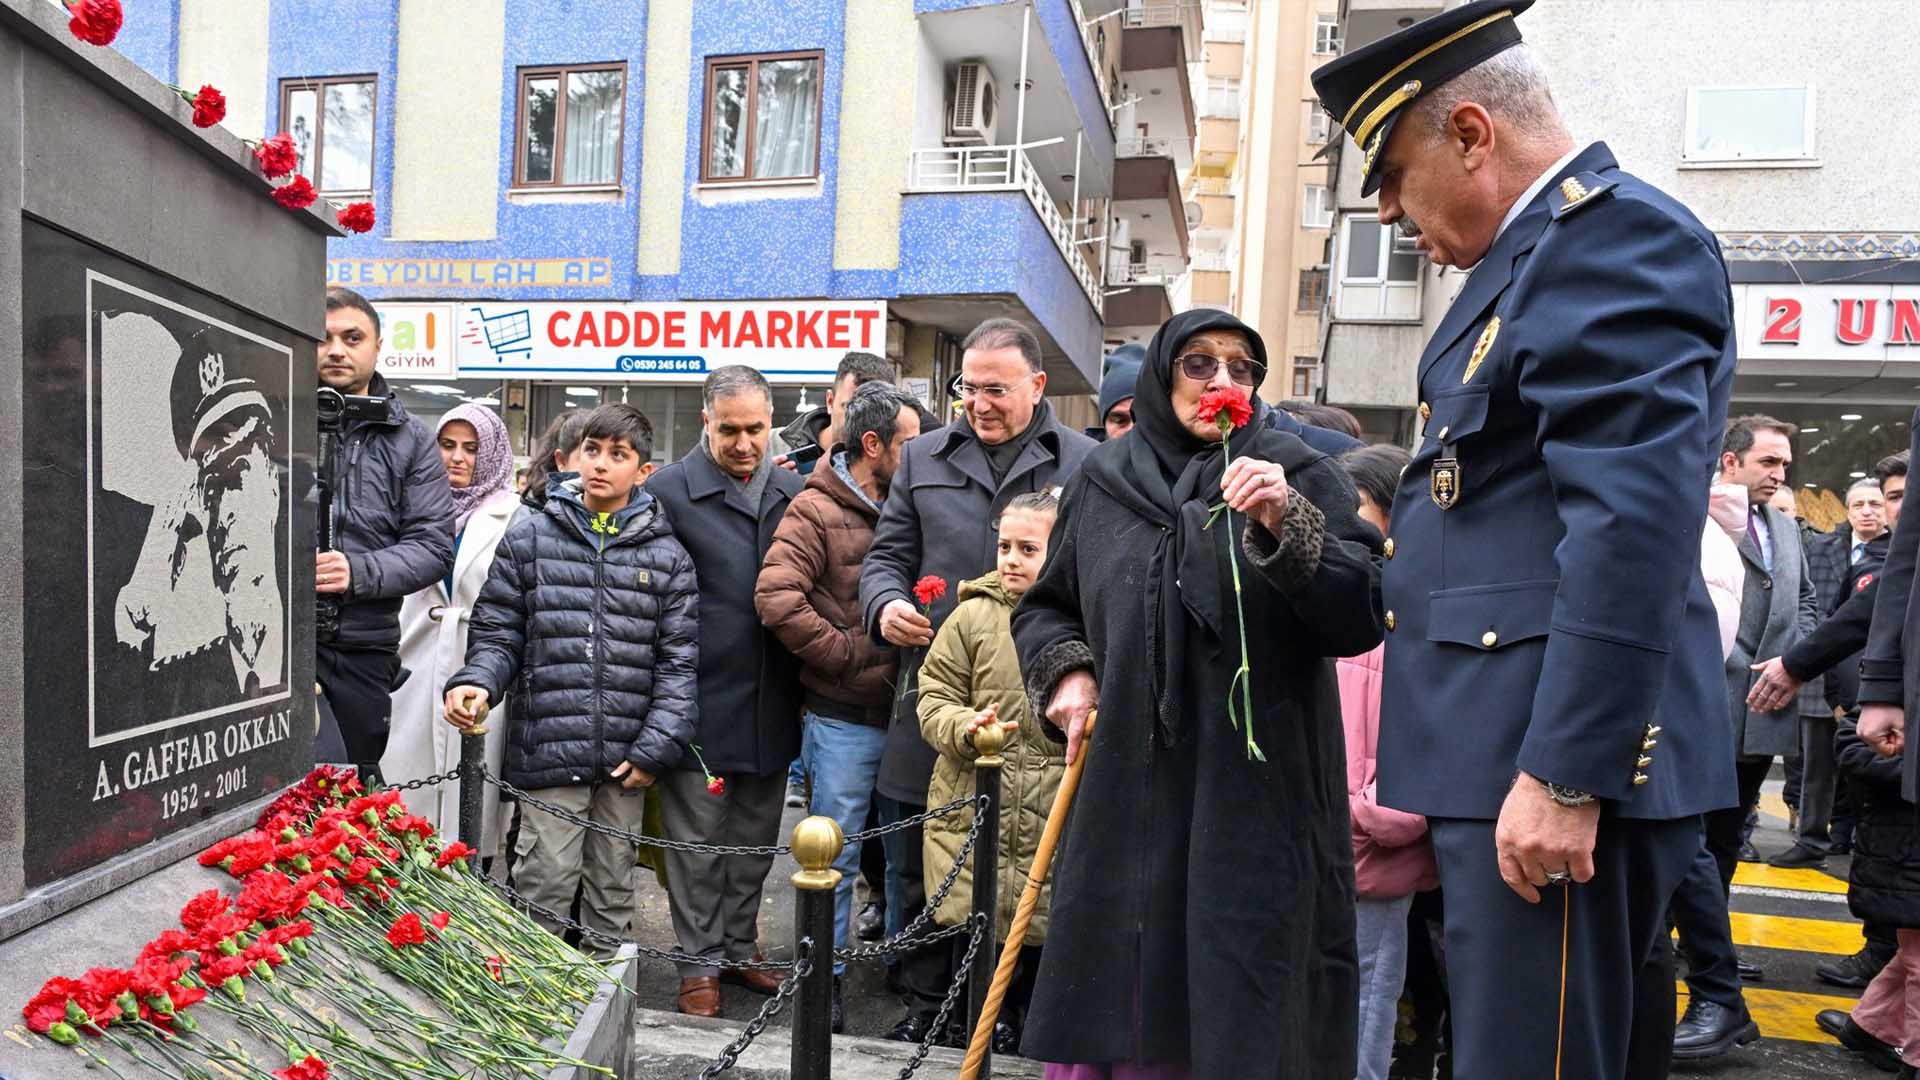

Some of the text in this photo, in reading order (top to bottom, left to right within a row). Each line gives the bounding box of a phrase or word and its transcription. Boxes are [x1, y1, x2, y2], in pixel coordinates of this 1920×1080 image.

[564, 261, 609, 282] AP
[379, 312, 435, 350] al
[547, 310, 879, 348] CADDE MARKET
[1761, 298, 1920, 346] 2 UN
[385, 352, 435, 368] GİYİM
[123, 730, 219, 791] GAFFAR
[223, 709, 292, 759] OKKAN
[160, 783, 198, 820] 1952
[215, 764, 248, 799] 2001
